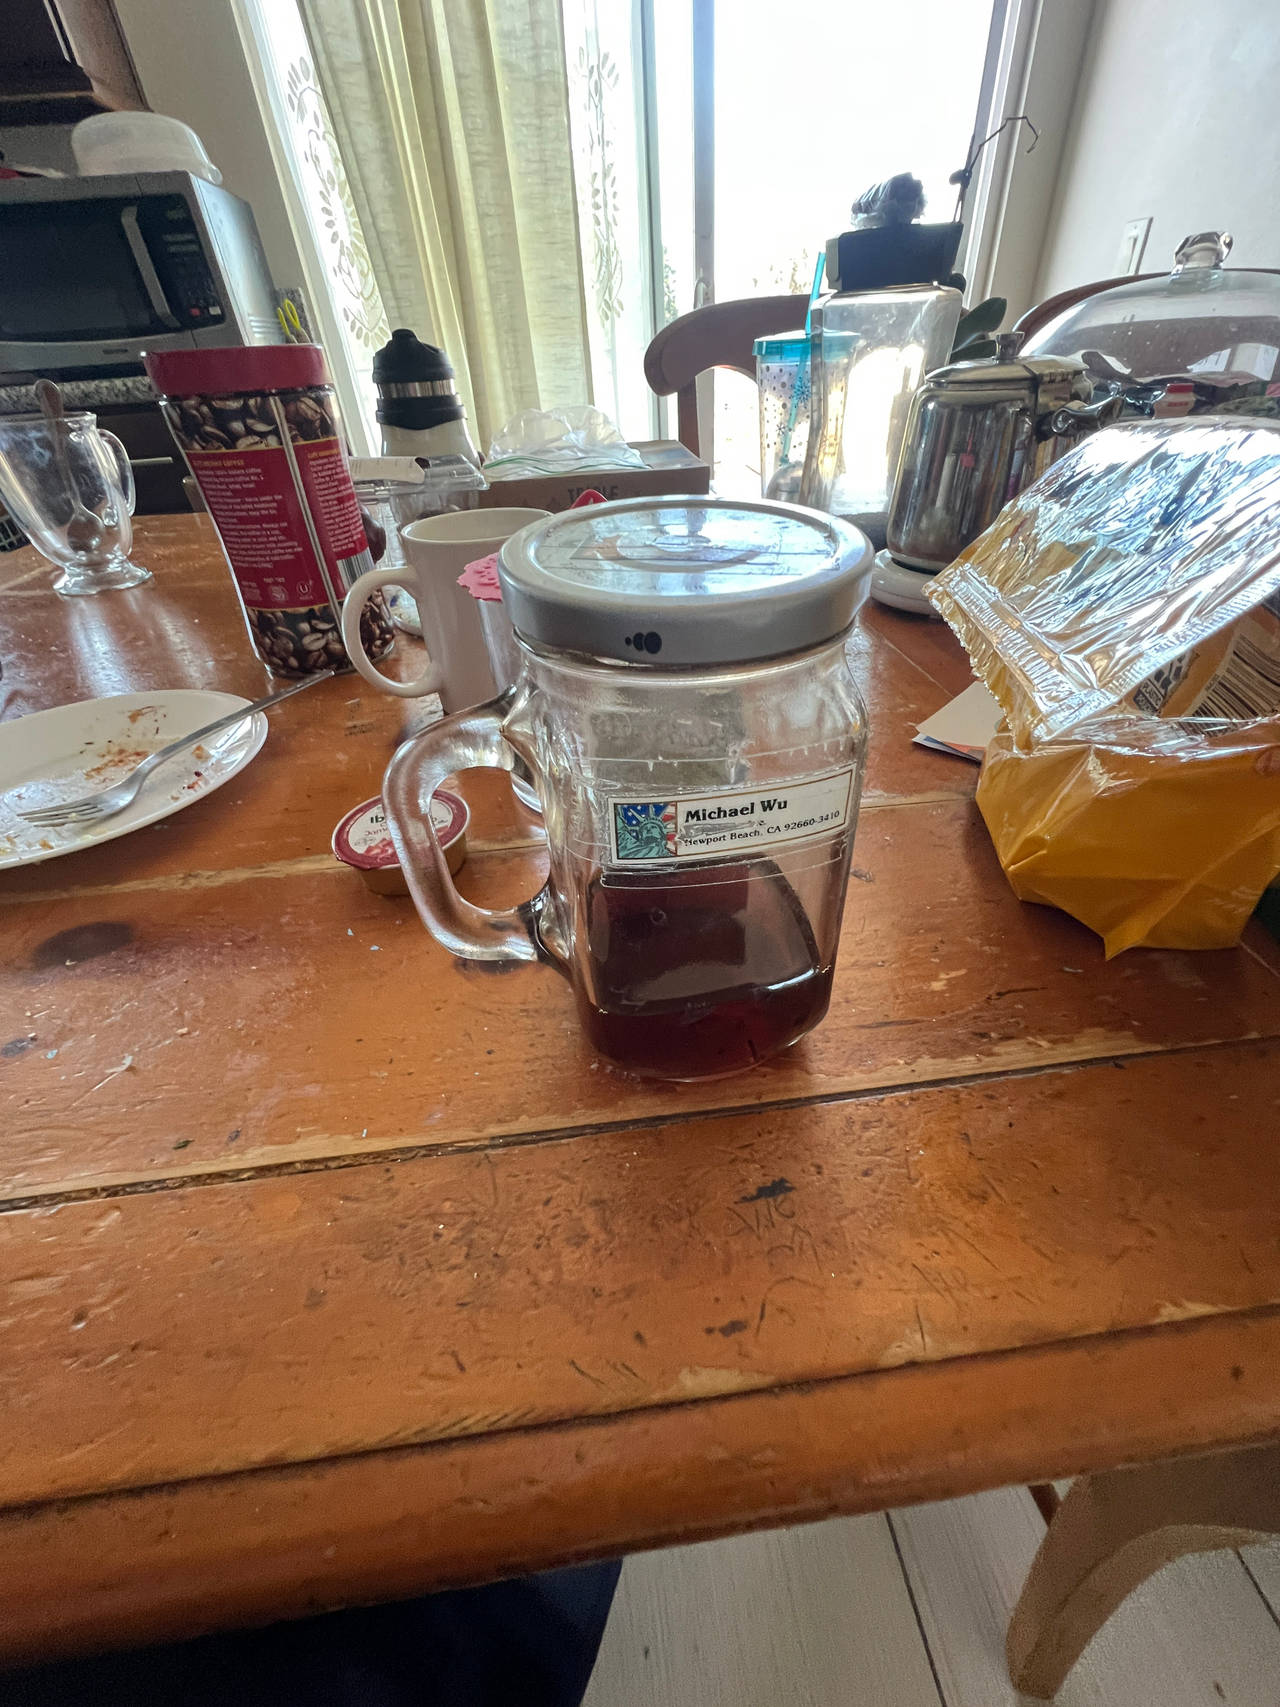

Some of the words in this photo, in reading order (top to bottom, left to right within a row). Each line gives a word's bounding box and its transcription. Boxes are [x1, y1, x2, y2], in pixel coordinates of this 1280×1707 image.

[685, 801, 755, 823] Michael
[760, 798, 788, 813] Wu
[683, 834, 726, 847] Newport
[766, 825, 781, 835] CA
